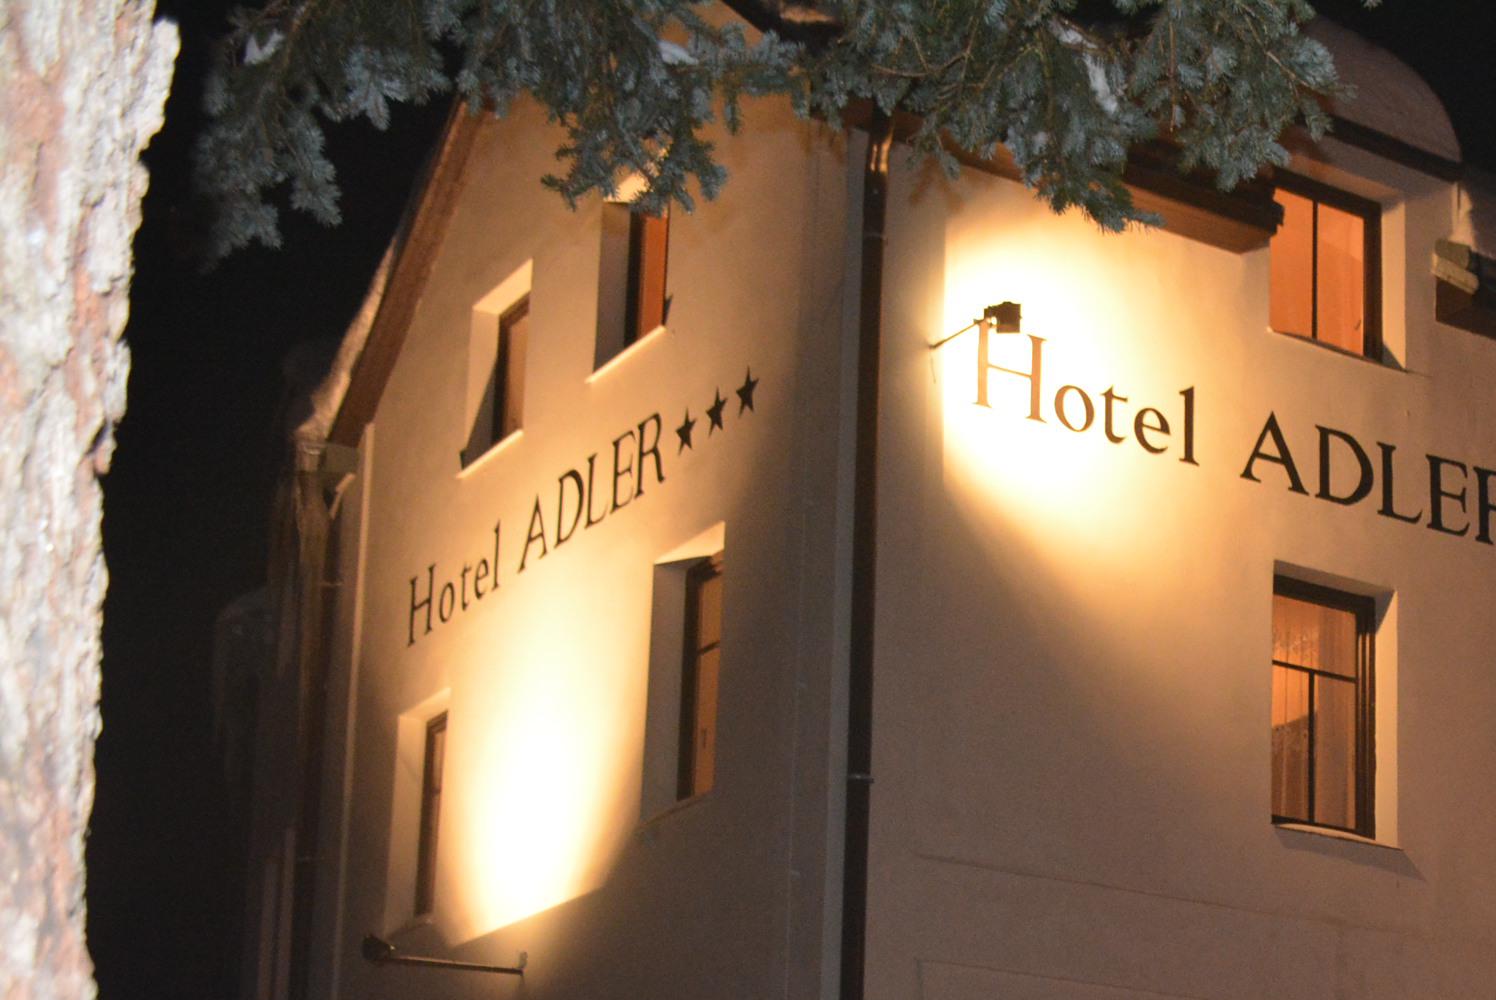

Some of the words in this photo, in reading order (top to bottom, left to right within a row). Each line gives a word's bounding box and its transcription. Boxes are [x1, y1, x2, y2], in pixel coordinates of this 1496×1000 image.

[973, 318, 1200, 467] Hotel
[407, 520, 501, 647] Hotel
[517, 412, 666, 574] ADLER
